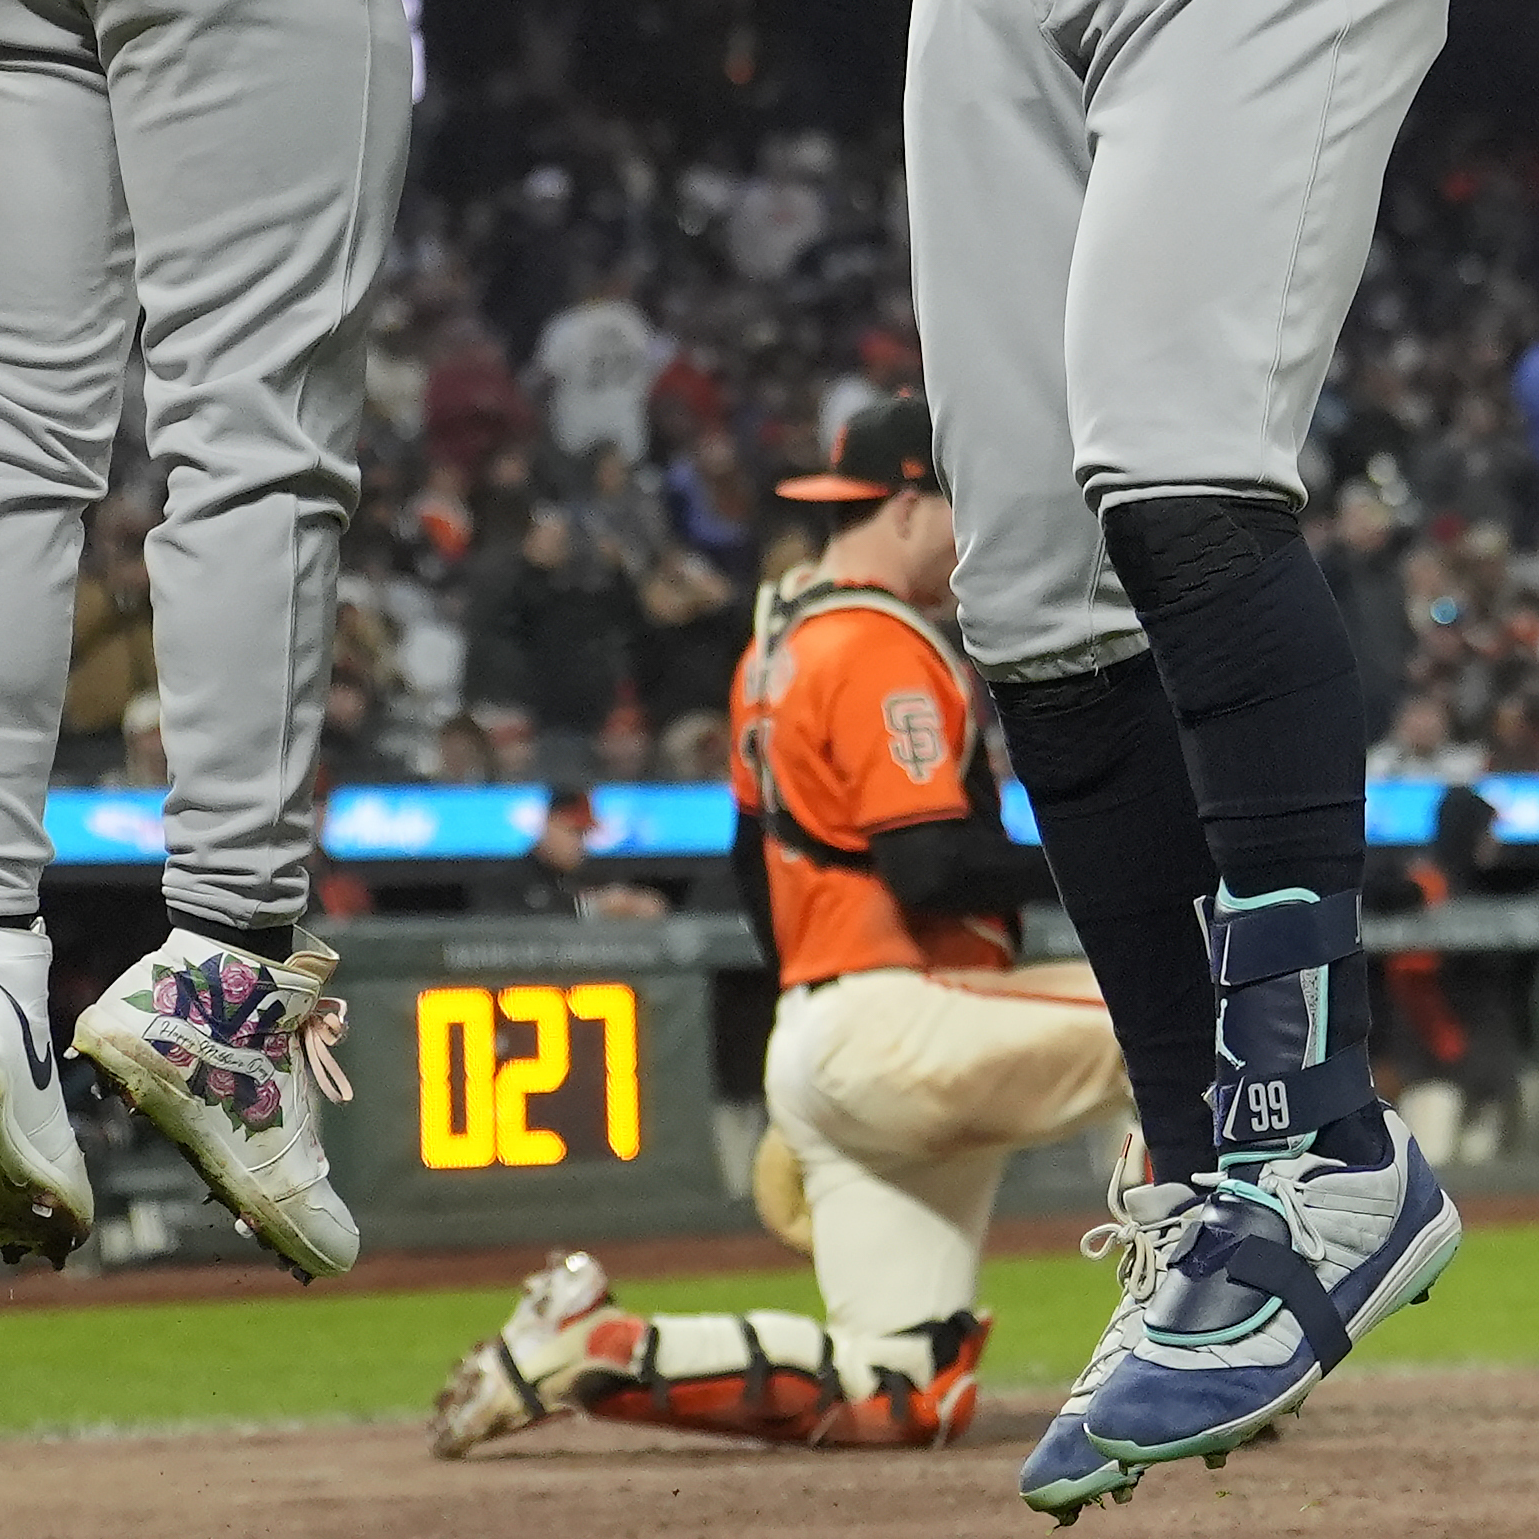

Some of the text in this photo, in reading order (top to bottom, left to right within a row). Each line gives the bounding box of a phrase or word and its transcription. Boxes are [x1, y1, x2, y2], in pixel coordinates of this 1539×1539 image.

[881, 691, 950, 786] SF
[416, 982, 643, 1170] 027
[1247, 1080, 1290, 1132] 99
